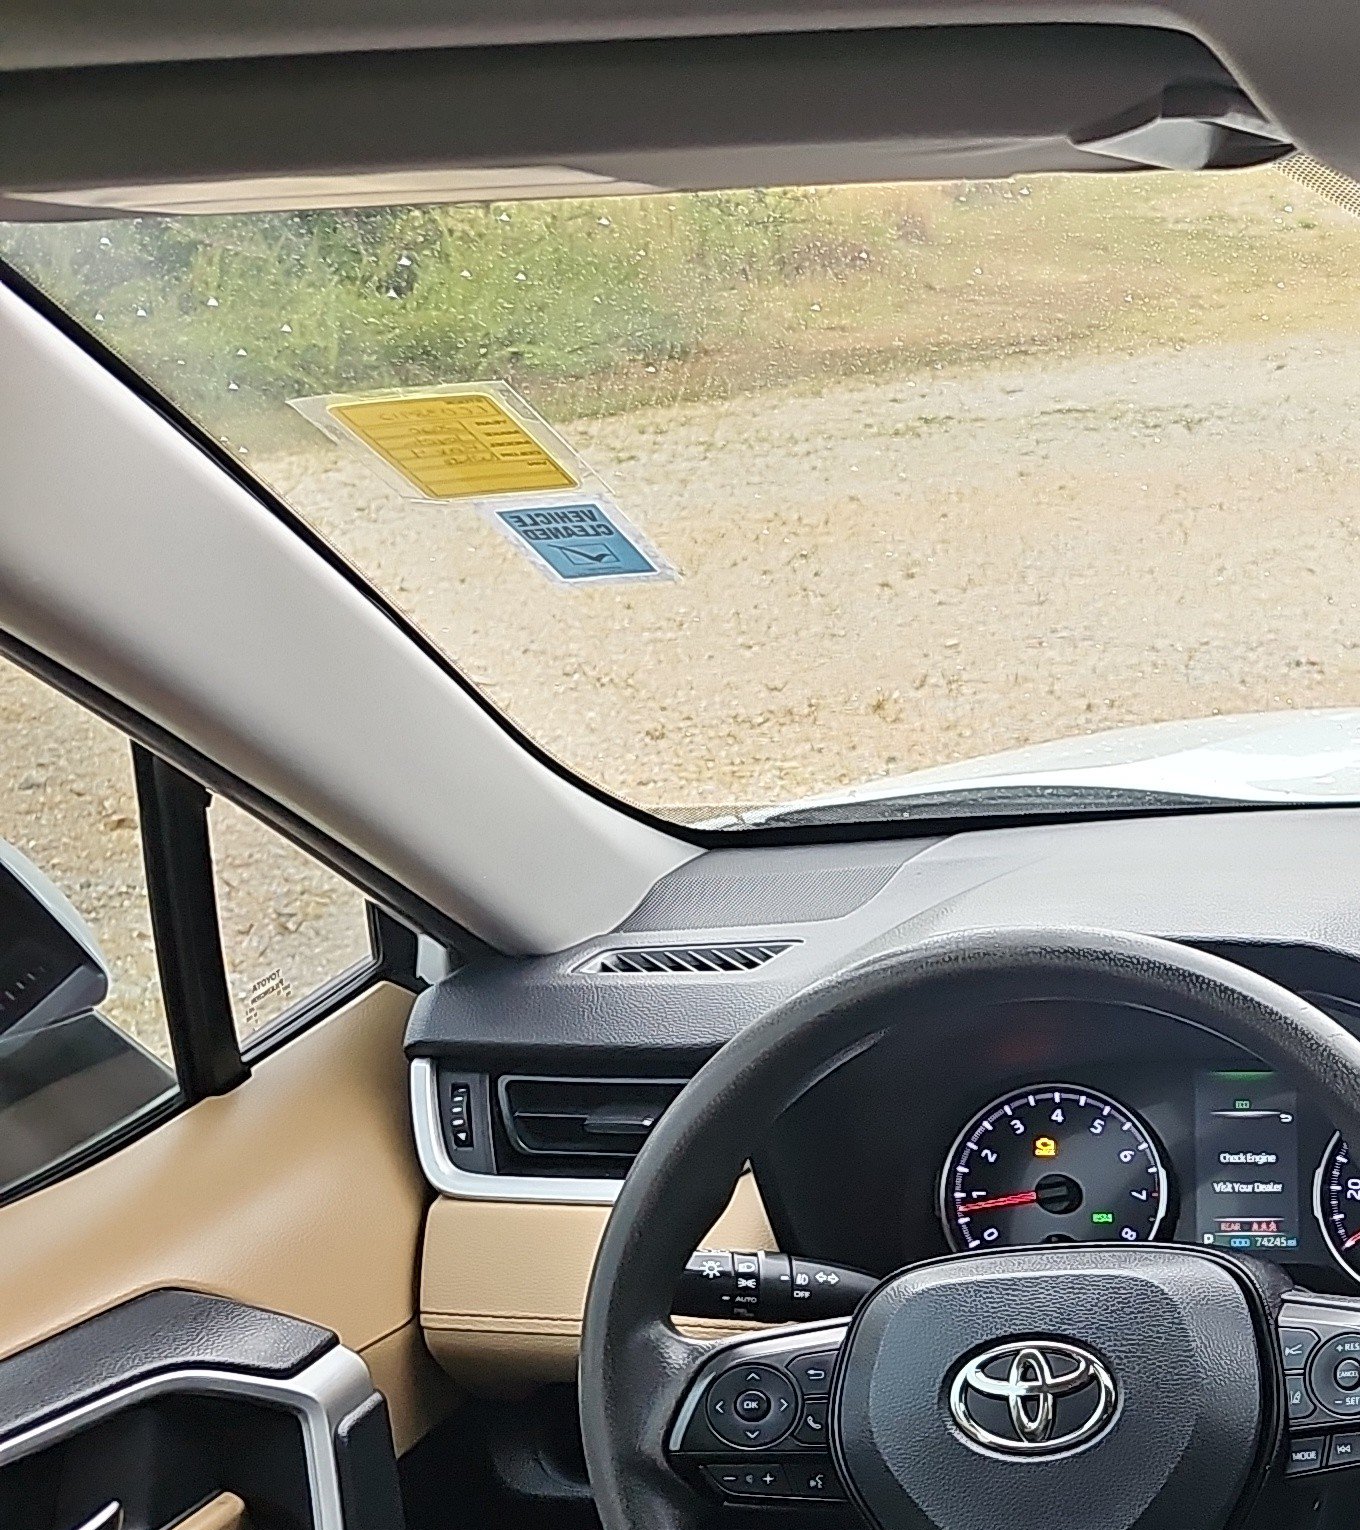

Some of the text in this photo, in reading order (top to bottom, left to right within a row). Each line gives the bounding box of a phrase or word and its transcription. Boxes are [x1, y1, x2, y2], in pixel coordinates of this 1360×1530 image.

[1051, 1109, 1064, 1123] 4
[1010, 1119, 1025, 1134] 3
[1090, 1119, 1105, 1134] 5
[981, 1149, 997, 1163] 2
[1119, 1150, 1135, 1163] 6
[1220, 1153, 1276, 1164] Check Engine
[1233, 1182, 1253, 1192] Your
[1254, 1182, 1282, 1192] Dealer
[1130, 1189, 1147, 1200] 7
[983, 1228, 998, 1240] 0
[1121, 1228, 1137, 1241] 8
[1255, 1237, 1286, 1247] 74245
[744, 1400, 759, 1410] OK
[1345, 1397, 1360, 1405] SET
